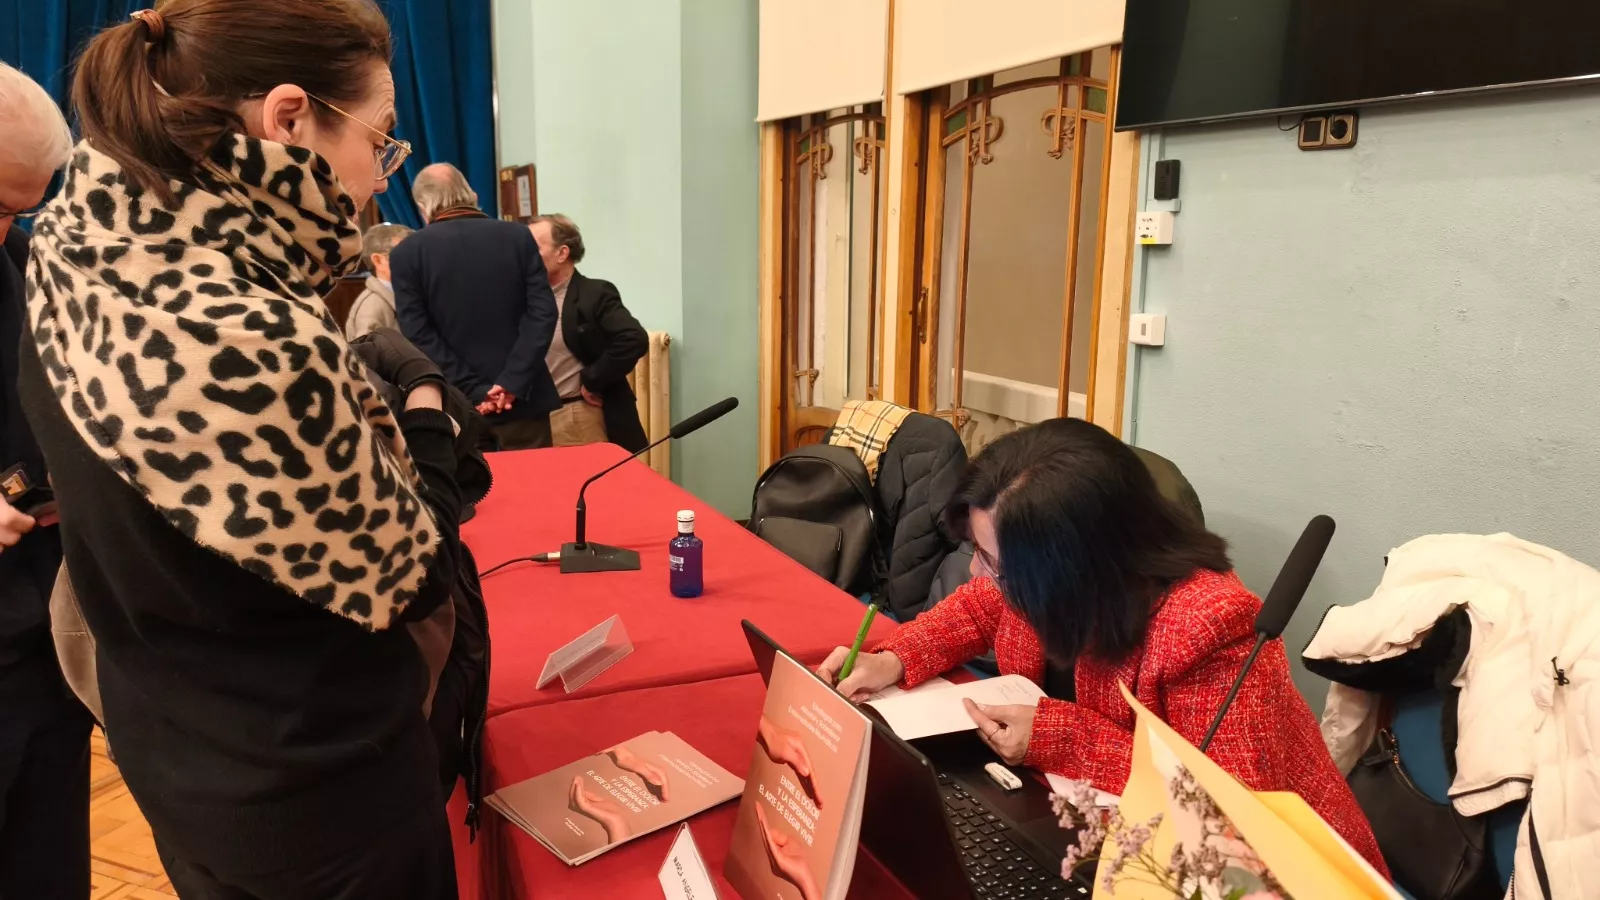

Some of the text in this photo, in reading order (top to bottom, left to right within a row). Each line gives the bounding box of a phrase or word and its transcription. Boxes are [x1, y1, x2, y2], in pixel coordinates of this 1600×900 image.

[620, 775, 638, 788] ENTRE
[640, 789, 660, 806] DOLOR
[781, 774, 796, 795] ENTRE
[801, 795, 820, 820] DOLOR
[765, 790, 777, 807] ARTE
[776, 801, 784, 815] DE
[783, 808, 800, 832] ELEGIR
[800, 826, 814, 848] VIVIR
